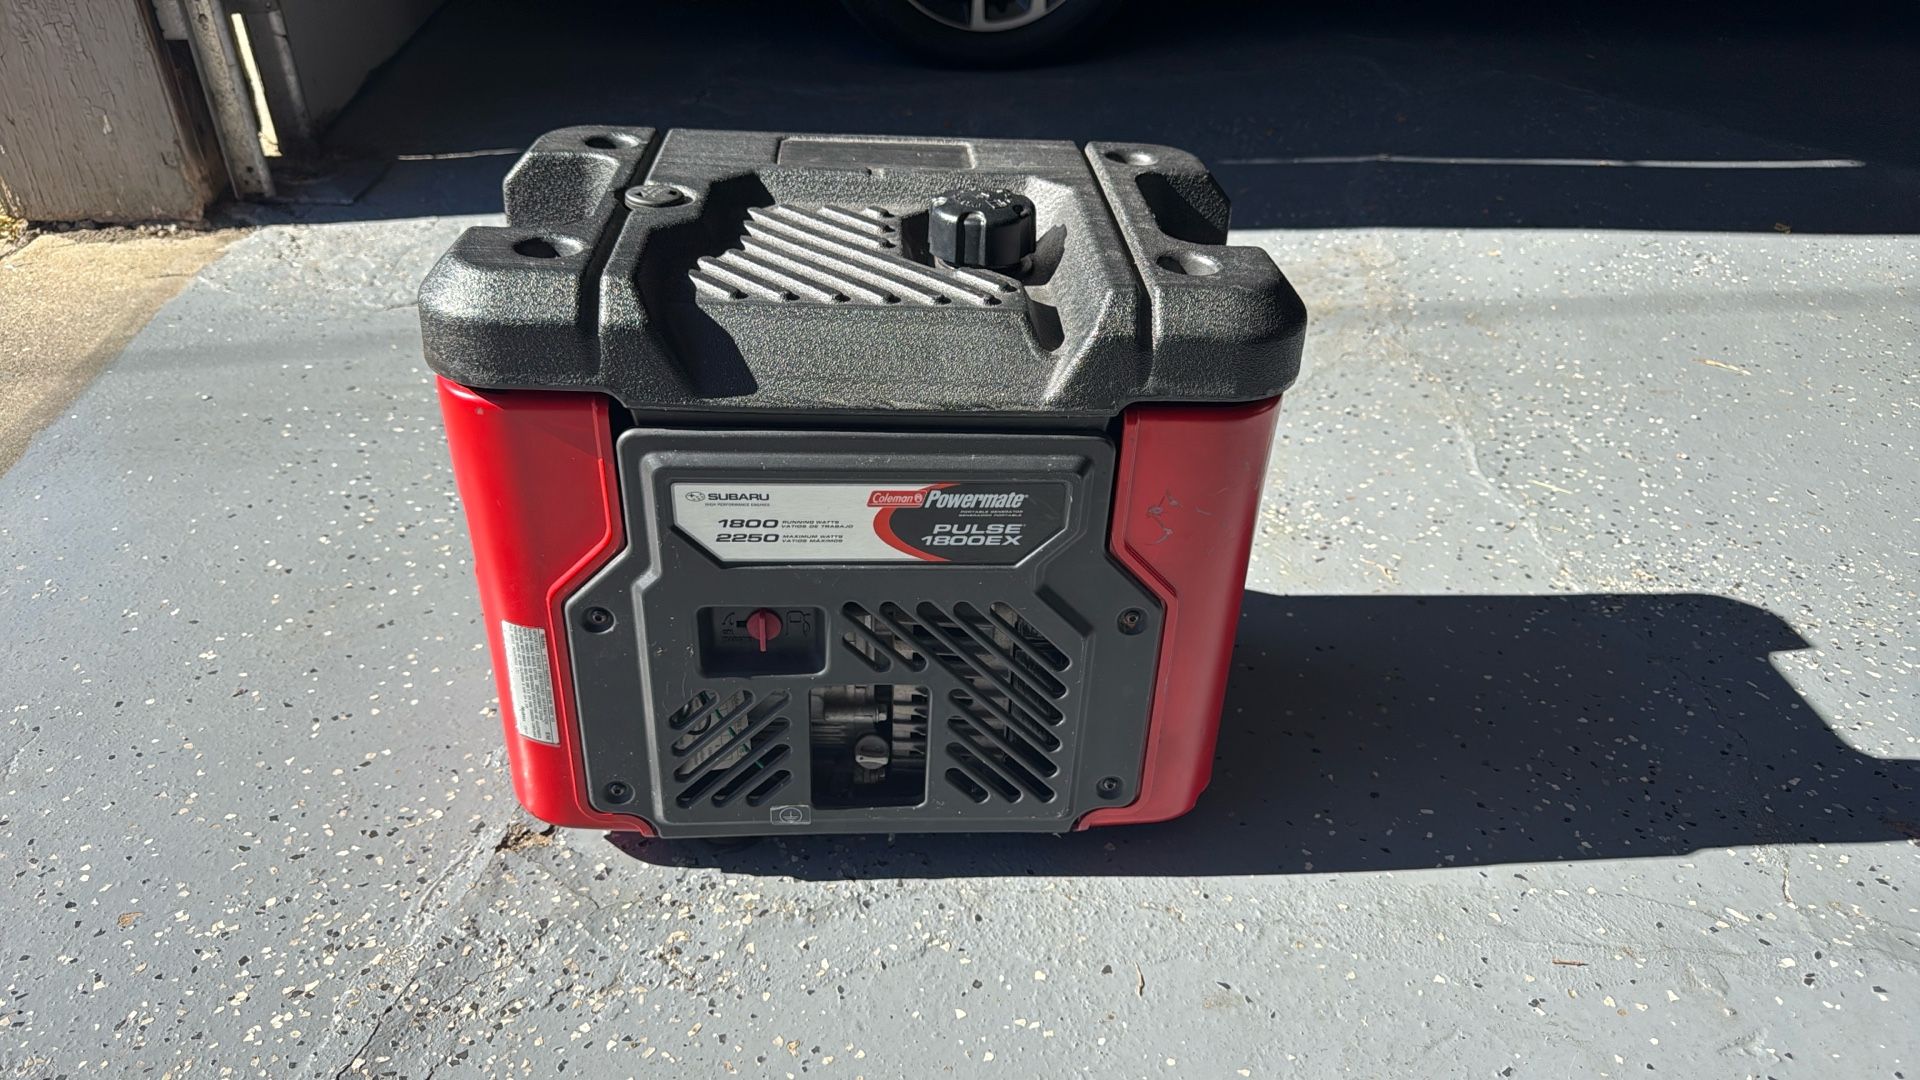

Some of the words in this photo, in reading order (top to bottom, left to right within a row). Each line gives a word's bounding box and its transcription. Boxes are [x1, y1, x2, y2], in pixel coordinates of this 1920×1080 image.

[708, 493, 770, 501] SUBARU
[872, 492, 913, 504] Coleman
[718, 519, 779, 529] 1800
[932, 524, 1023, 534] PULSE
[715, 533, 780, 543] 2250
[921, 535, 1023, 546] 1800EX
